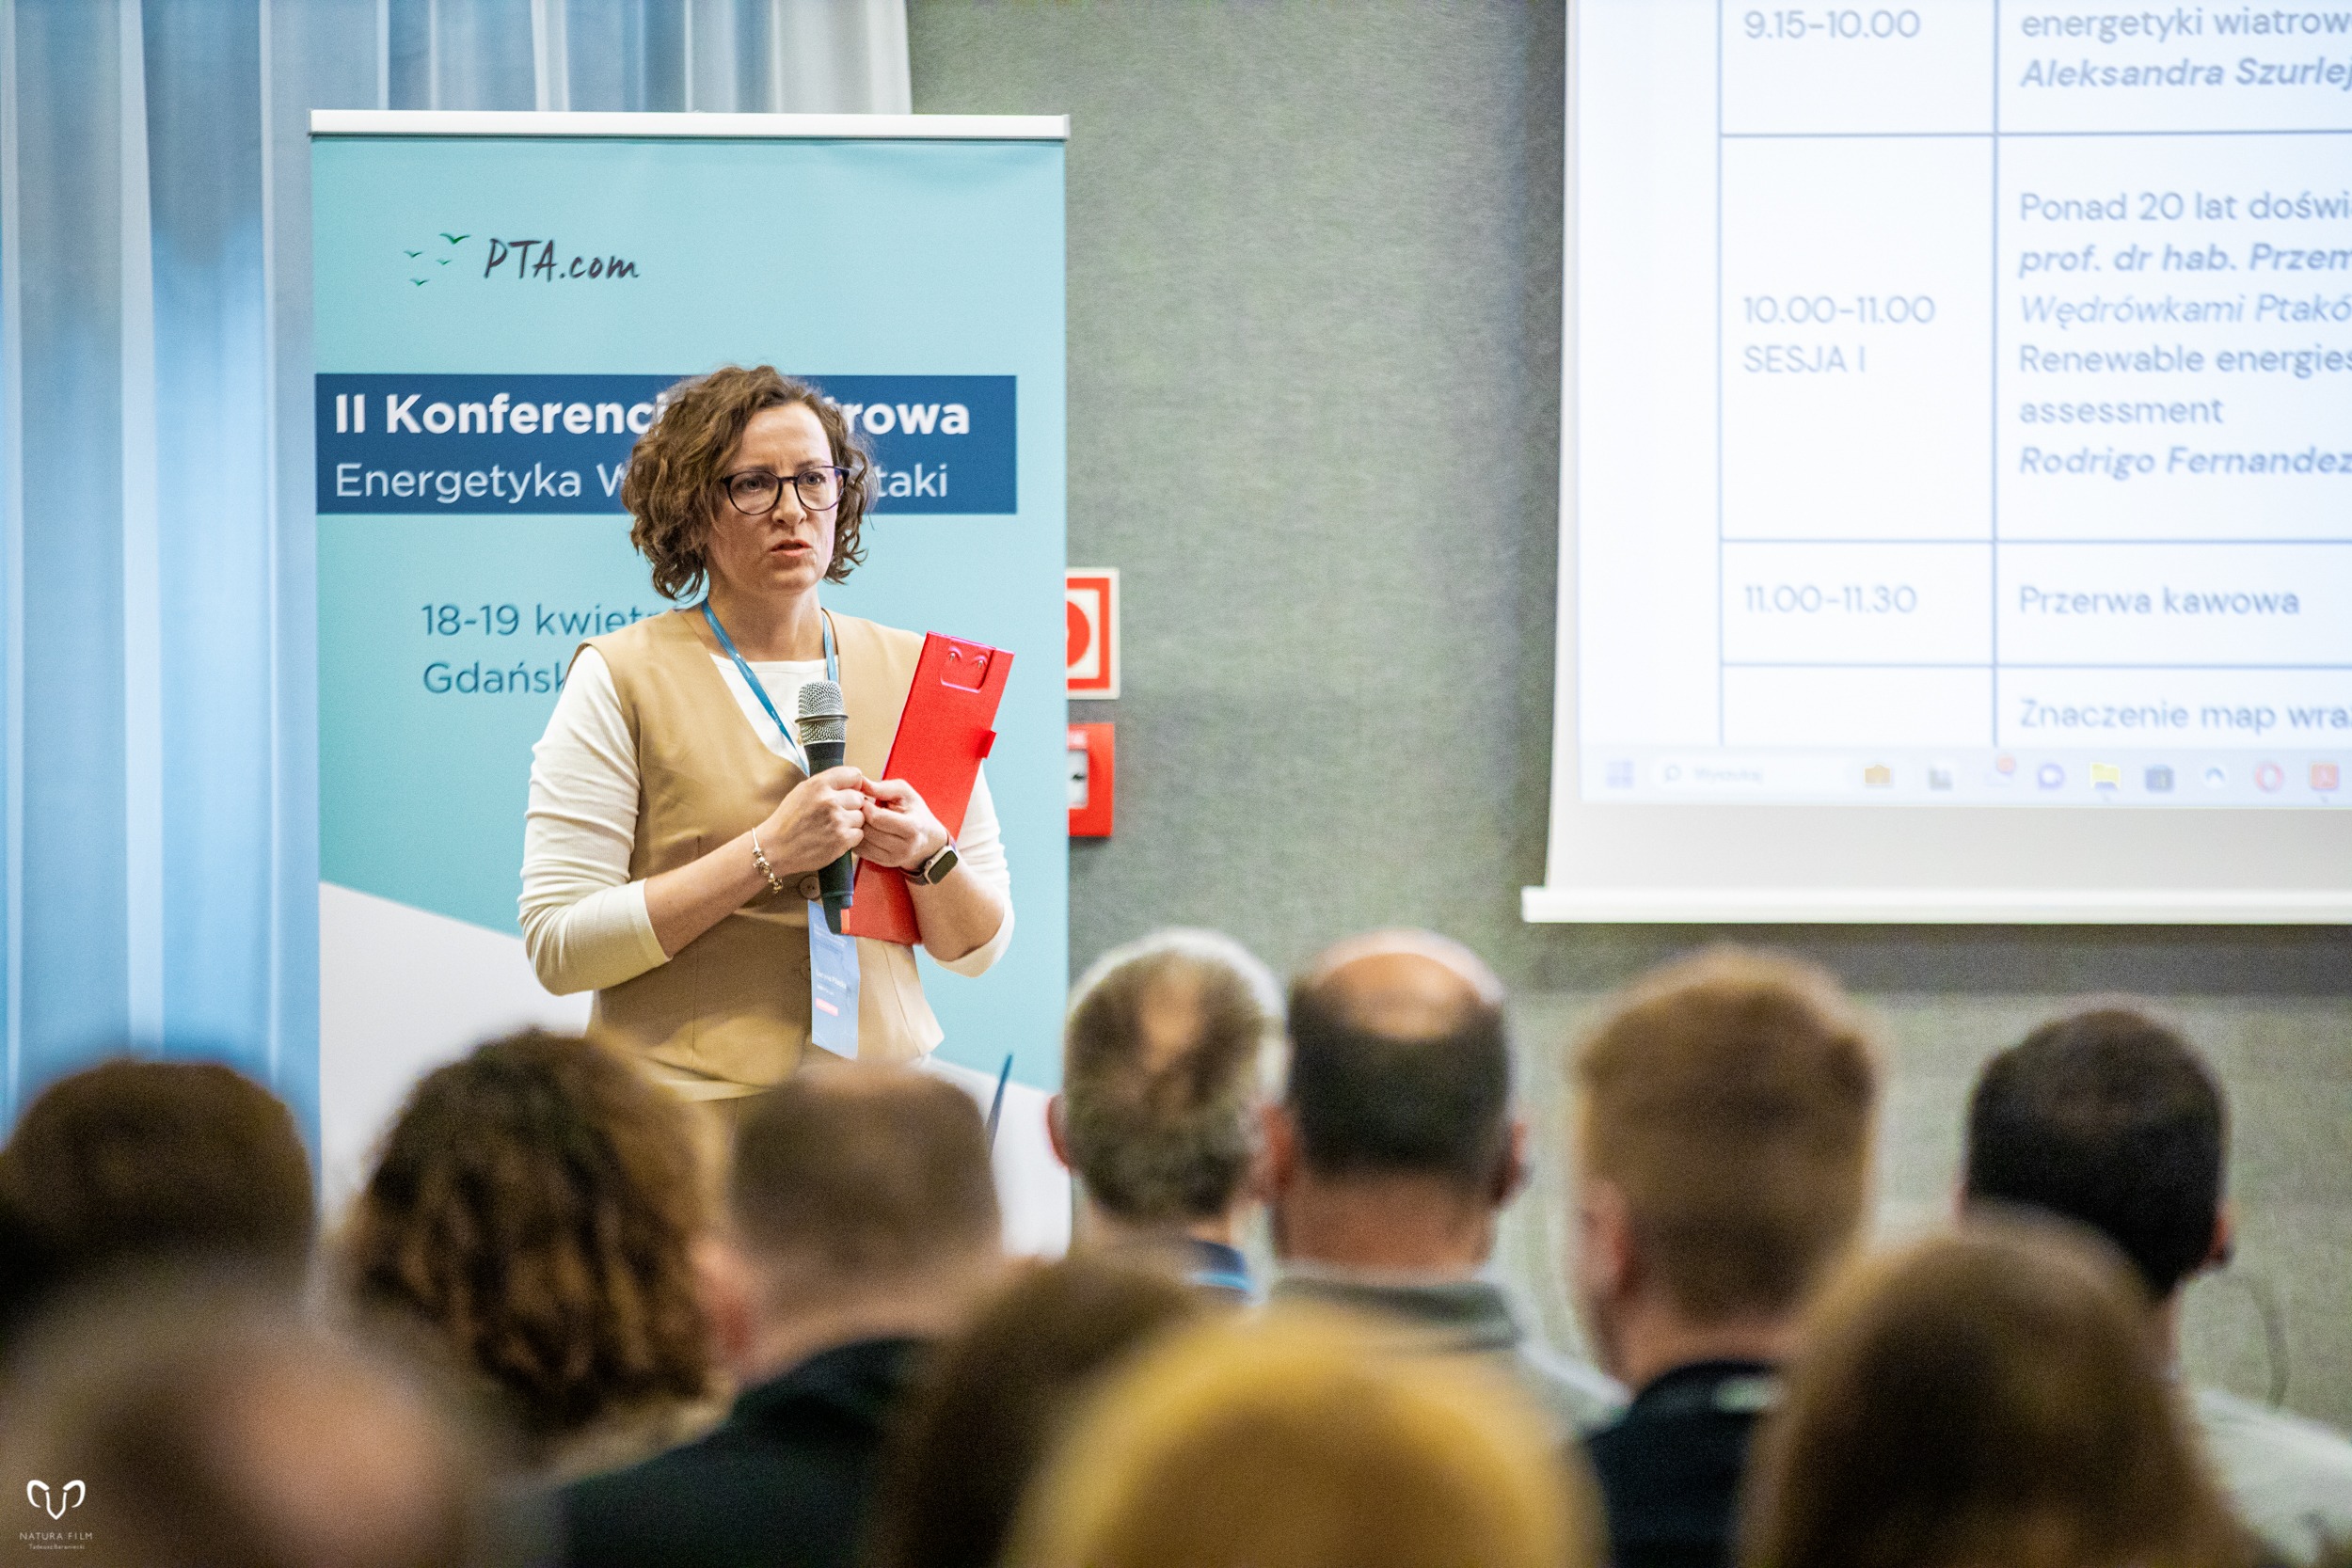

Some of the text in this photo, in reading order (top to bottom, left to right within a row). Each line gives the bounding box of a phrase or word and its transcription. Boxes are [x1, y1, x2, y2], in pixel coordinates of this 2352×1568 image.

[2021, 7, 2352, 44] energetyki wiatrow
[2020, 57, 2225, 87] Aleksandra
[2019, 190, 2352, 222] Ponad 20 lat doświ
[484, 237, 641, 282] PTA.com
[2017, 243, 2102, 279] prof.
[2113, 243, 2153, 272] dr
[2162, 243, 2237, 271] hab.
[2020, 293, 2352, 330] Wędrówkami Ptakó
[1742, 343, 1848, 373] SESJA
[2019, 343, 2205, 372] Renewable
[336, 393, 365, 434] II
[824, 396, 970, 435] rowa
[2019, 399, 2223, 424] assessment
[2019, 445, 2352, 481] Rodrigo Fernandez
[336, 462, 581, 504] Energetyka
[873, 463, 947, 498] taki
[2019, 585, 2301, 614] Przerwa kawowa
[421, 603, 662, 637] 18-19 kwiet
[423, 660, 566, 694] Gdańsk
[2020, 697, 2352, 736] Znaczenie map wra
